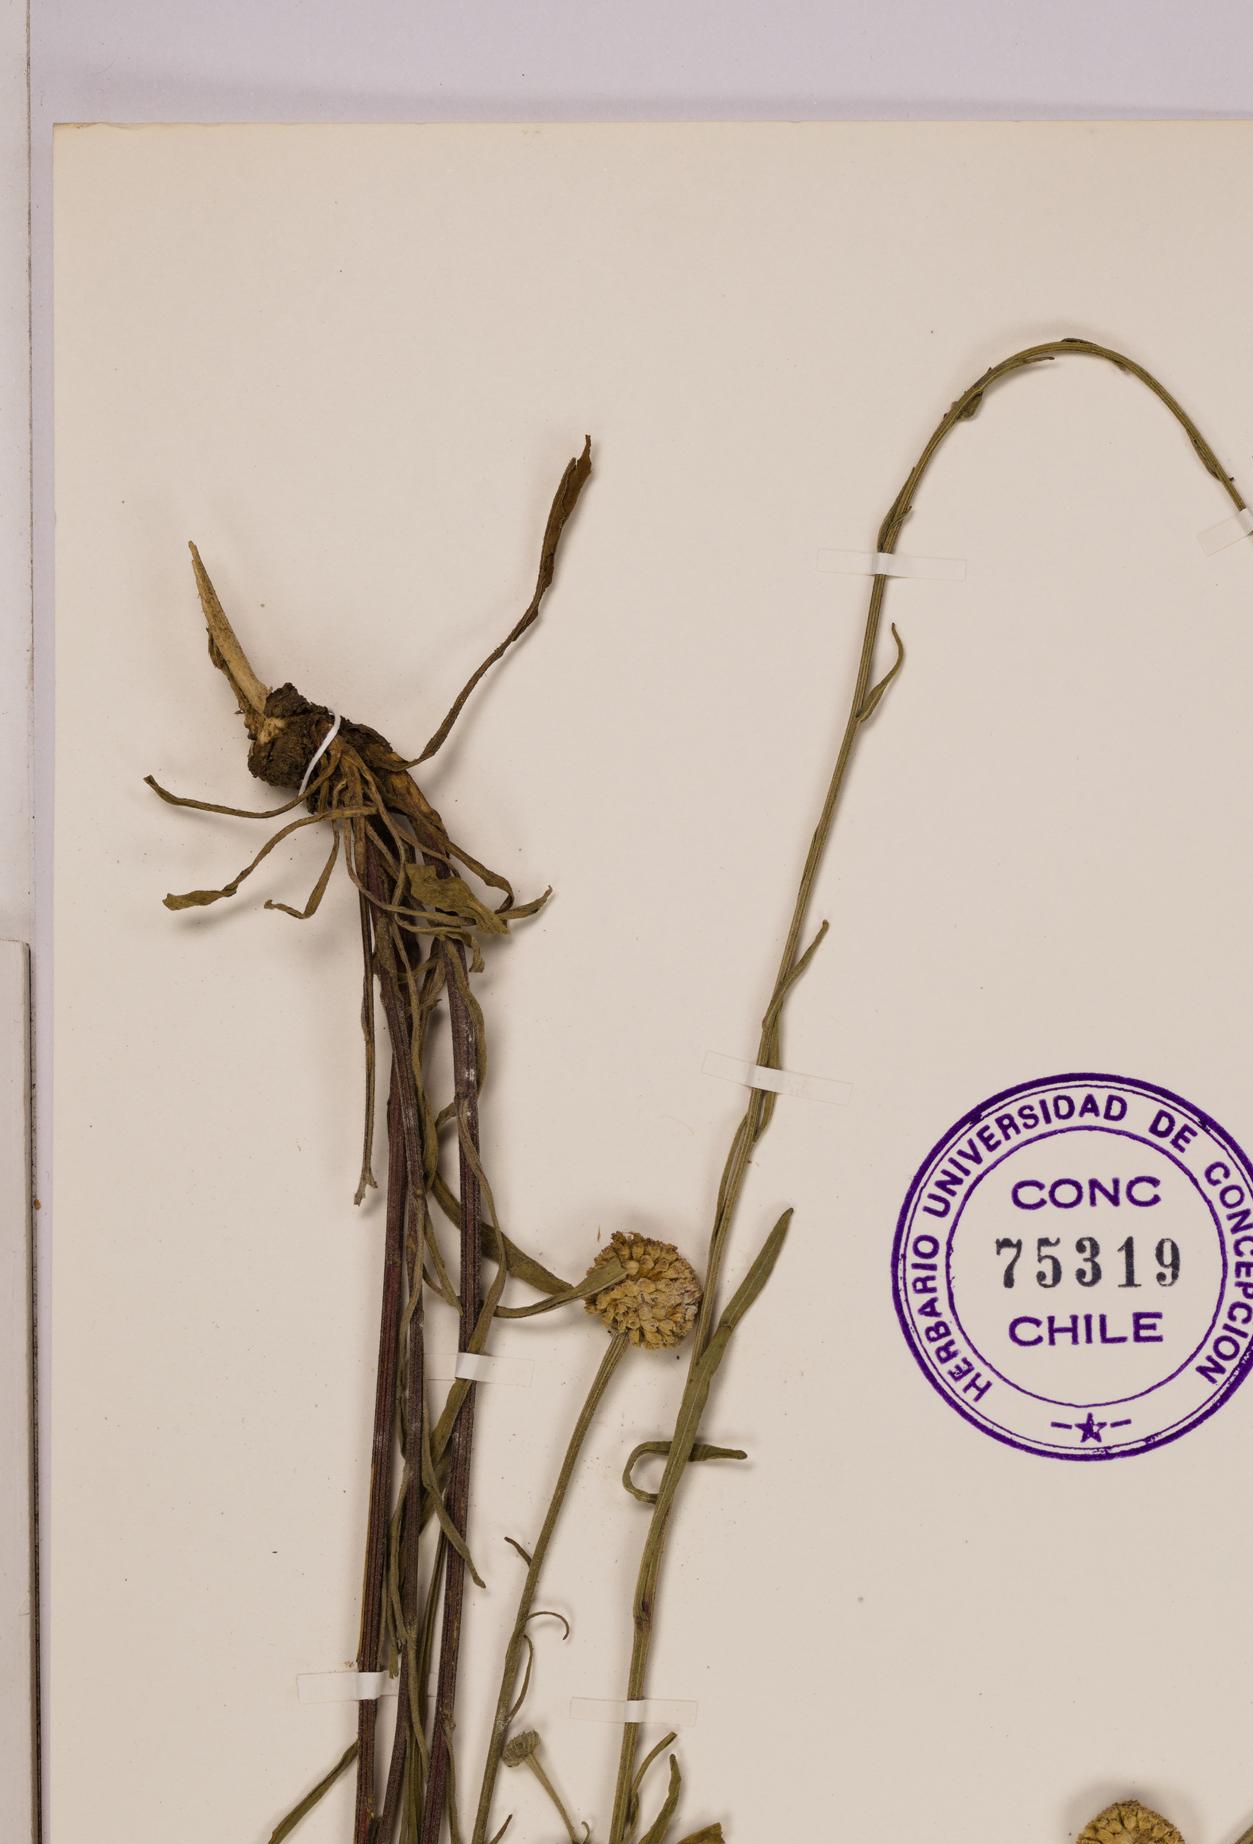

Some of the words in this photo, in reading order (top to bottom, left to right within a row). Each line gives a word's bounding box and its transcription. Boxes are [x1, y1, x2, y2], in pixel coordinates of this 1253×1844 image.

[923, 1093, 1128, 1219] UNIVERSIDAD
[1148, 1109, 1199, 1154] DE
[1010, 1175, 1162, 1211] CONC
[994, 1235, 1182, 1290] 75319
[910, 1234, 994, 1403] HERBARIO
[1008, 1311, 1164, 1348] CHILE
